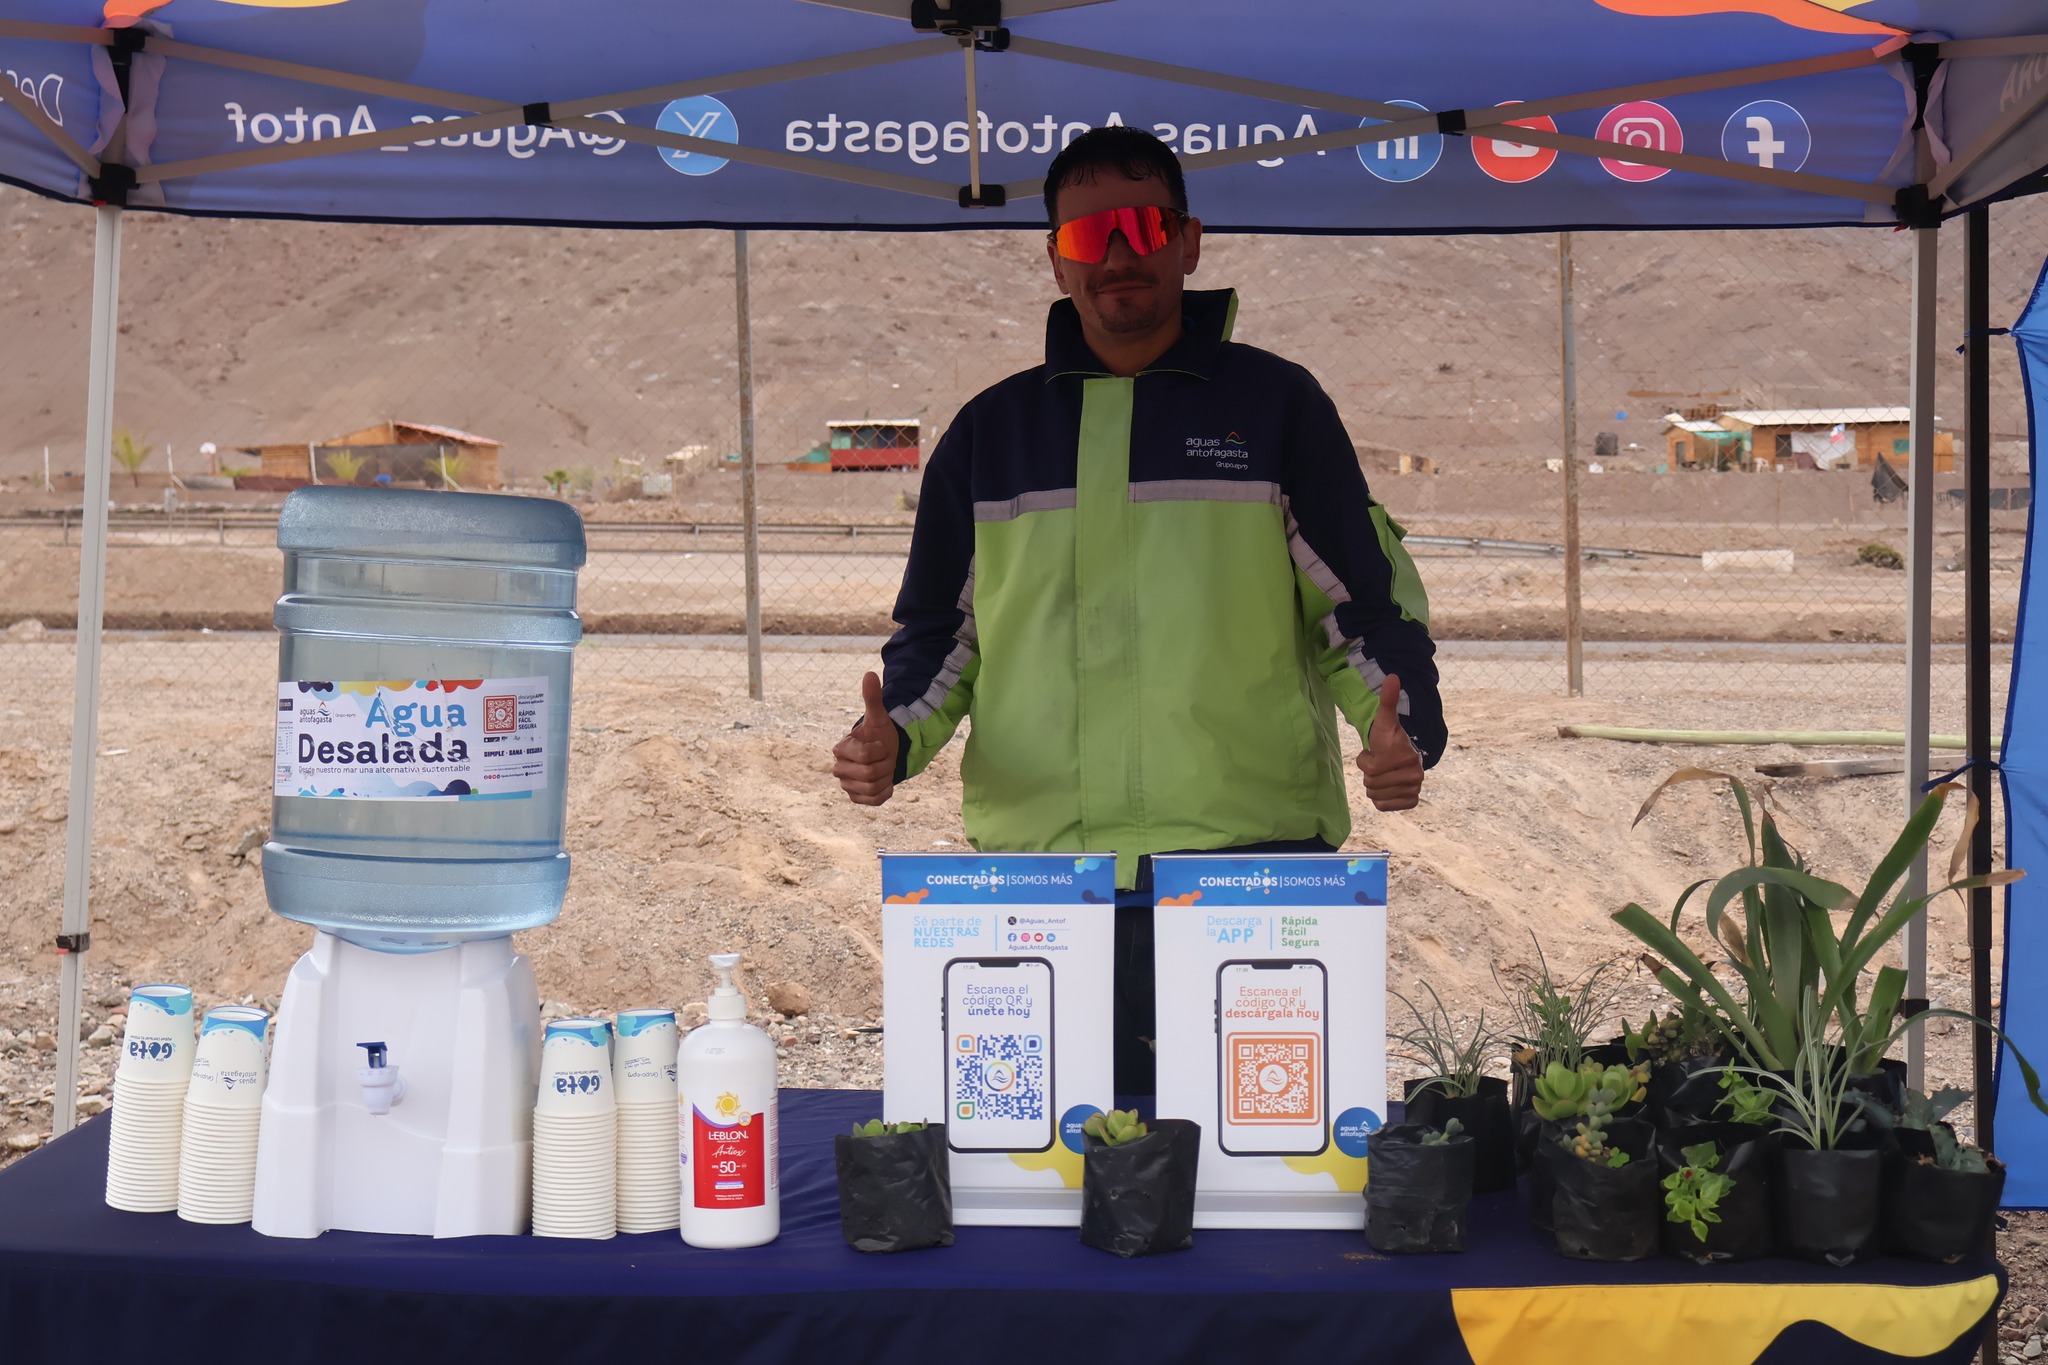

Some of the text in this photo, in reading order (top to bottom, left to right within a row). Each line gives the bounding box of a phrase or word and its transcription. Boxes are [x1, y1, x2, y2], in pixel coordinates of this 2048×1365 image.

[1185, 437, 1220, 448] aguas
[1186, 448, 1249, 459] antofagasta
[299, 708, 316, 717] aguas
[365, 697, 467, 737] Agua
[299, 716, 333, 725] antofagasta
[298, 731, 469, 764] Desalada
[316, 766, 342, 774] nuestro
[1010, 874, 1049, 886] SOMOS
[1050, 872, 1073, 885] MÁS
[1283, 876, 1321, 887] SOMOS
[1323, 874, 1346, 887] MÁS
[913, 914, 982, 930] Sé parte de
[1019, 917, 1066, 926] @Aguas_Antof
[1206, 915, 1262, 928] Descarga
[1281, 916, 1318, 928] Rápida
[913, 927, 980, 937] NUESTRAS
[1206, 926, 1255, 944] la APP
[1281, 926, 1307, 936] Fácil
[913, 938, 954, 948] REDES
[1281, 938, 1320, 949] Segura
[966, 984, 1029, 995] Escanea el
[1239, 986, 1302, 997] Escanea el
[962, 995, 1033, 1008] código QR y
[1235, 997, 1307, 1010] código QR y
[967, 1005, 1031, 1019] únete hoy
[1225, 1008, 1320, 1021] descárgala hoy
[708, 1130, 748, 1140] LEBLON
